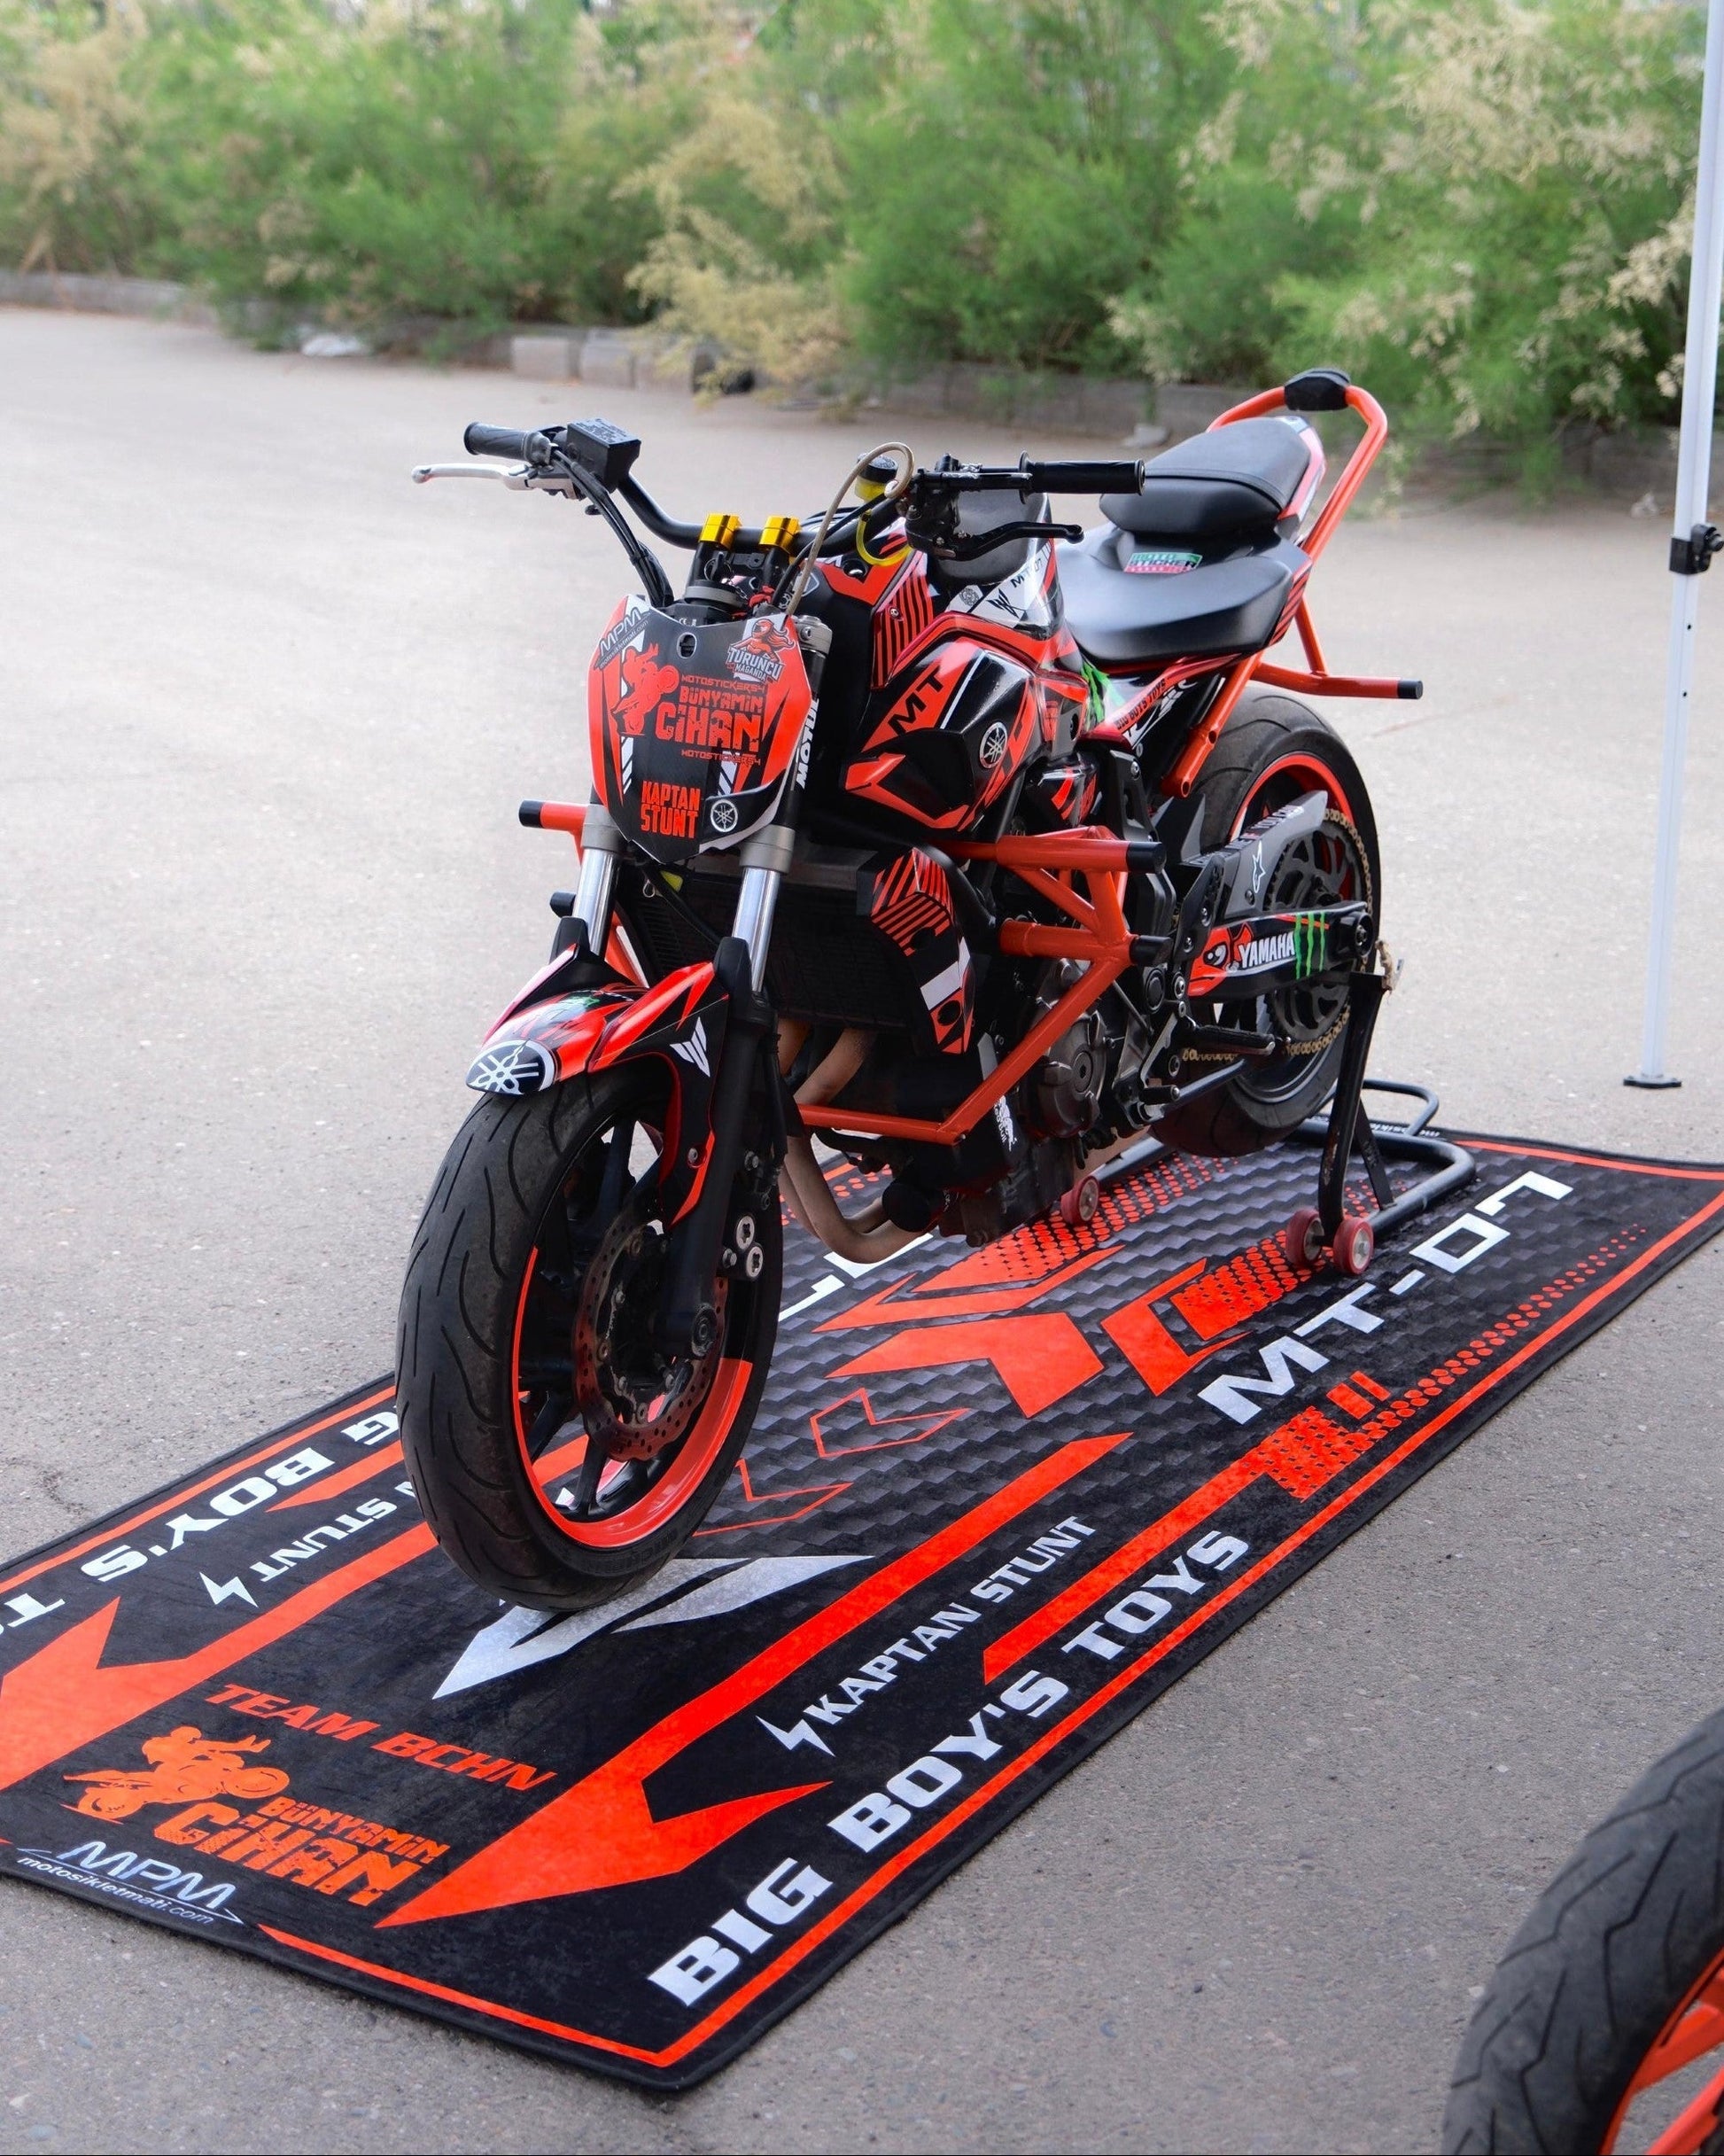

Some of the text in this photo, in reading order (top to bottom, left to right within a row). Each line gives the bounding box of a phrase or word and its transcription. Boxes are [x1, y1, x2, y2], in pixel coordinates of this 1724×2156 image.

[600, 608, 641, 657] MPM
[888, 671, 944, 736] MT
[796, 698, 819, 790] MOTUL
[641, 781, 701, 811] KAPTAN
[641, 804, 699, 838] STUNT
[1239, 931, 1295, 969] YAMAHA
[1197, 1171, 1573, 1425] MT-07
[81, 1447, 335, 1583] BOY'S
[249, 1498, 397, 1582] STUNT
[803, 1515, 1096, 1725] KAPTAN STUNT
[205, 1684, 557, 1792] TEAM BCHN
[647, 1530, 1249, 2007] BIG BOY'S TOYS
[17, 1857, 214, 1925] motosikletmati.com
[56, 1841, 236, 1909] MPM
